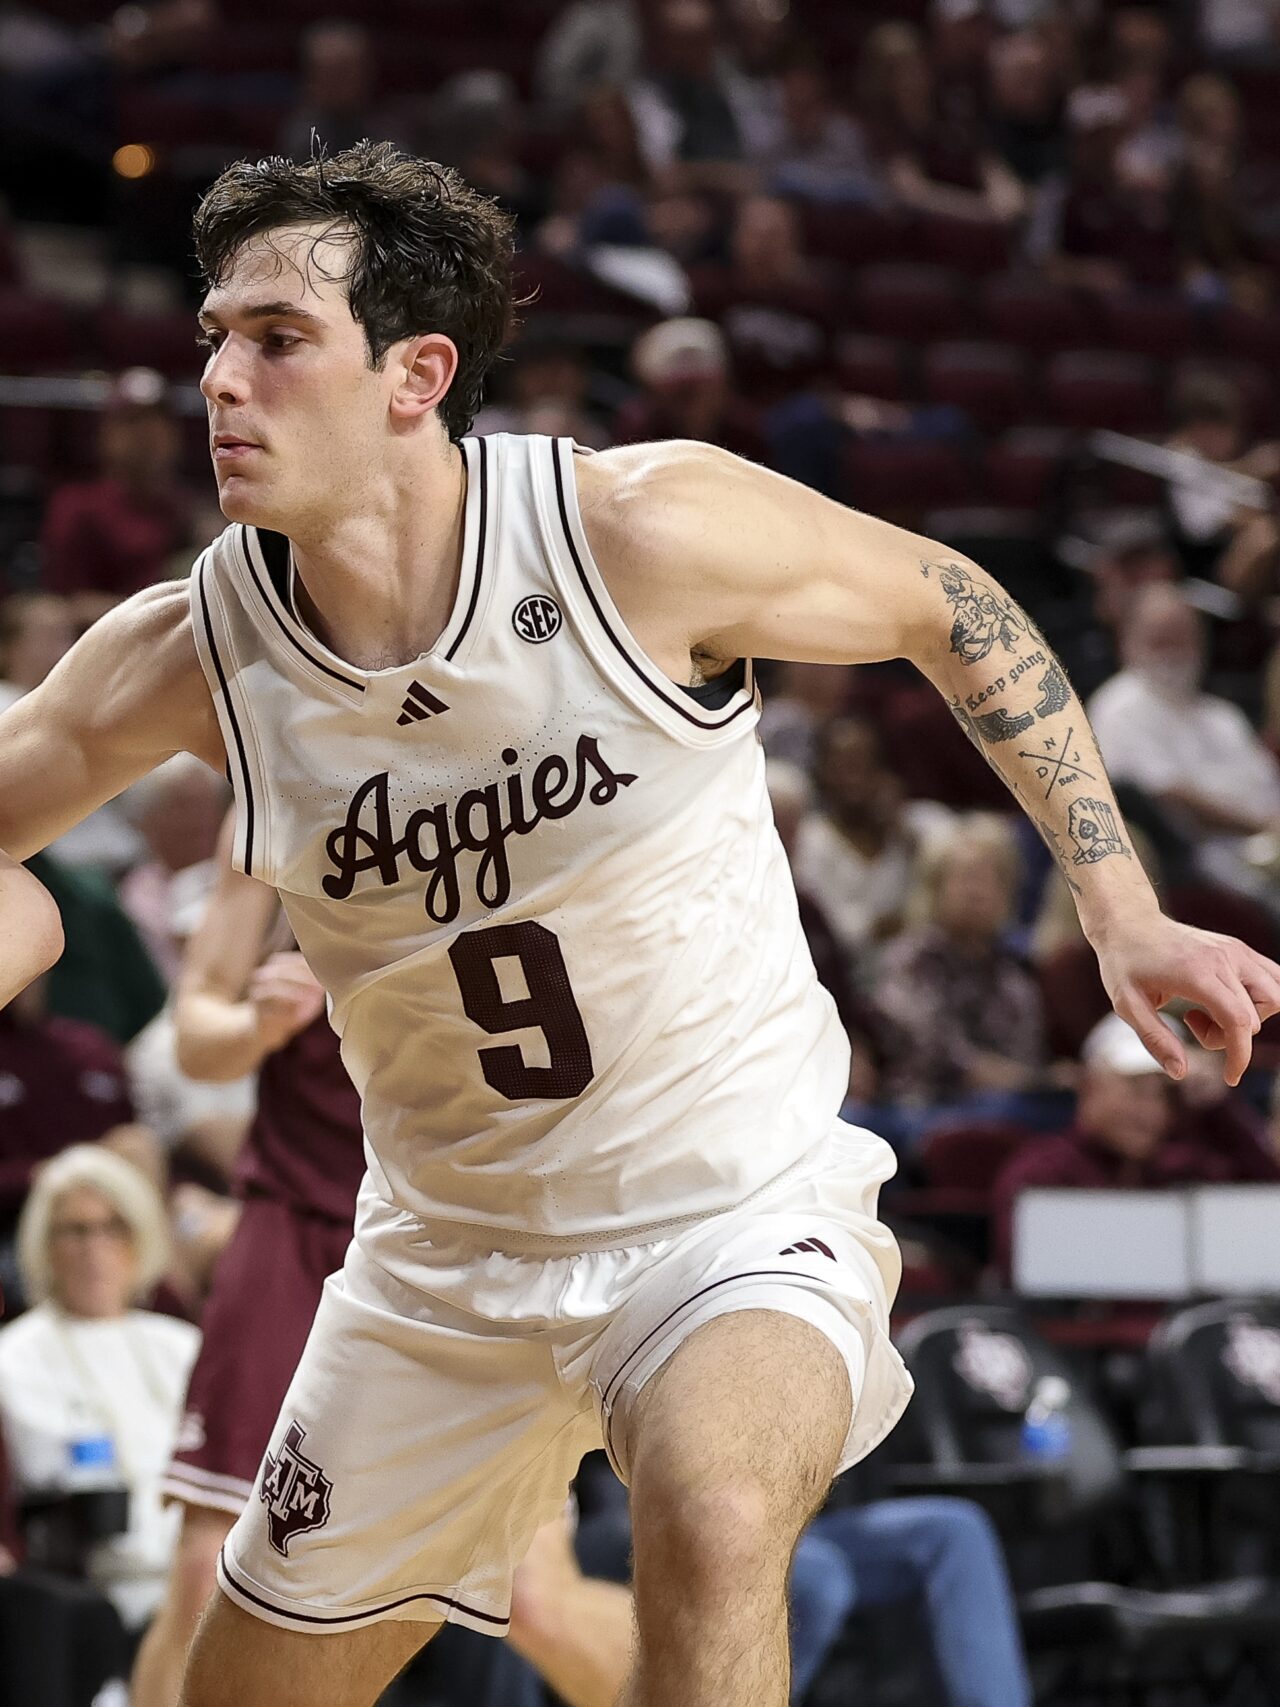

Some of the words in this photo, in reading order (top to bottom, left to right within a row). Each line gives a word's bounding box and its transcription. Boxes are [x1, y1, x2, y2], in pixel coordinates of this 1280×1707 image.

[517, 599, 558, 639] SEC
[965, 676, 1006, 712] Keep
[1009, 651, 1046, 684] going
[1042, 736, 1057, 751] N
[1073, 751, 1081, 763] J
[1035, 766, 1049, 779] D
[322, 734, 639, 924] Aggies
[447, 920, 595, 1101] 9
